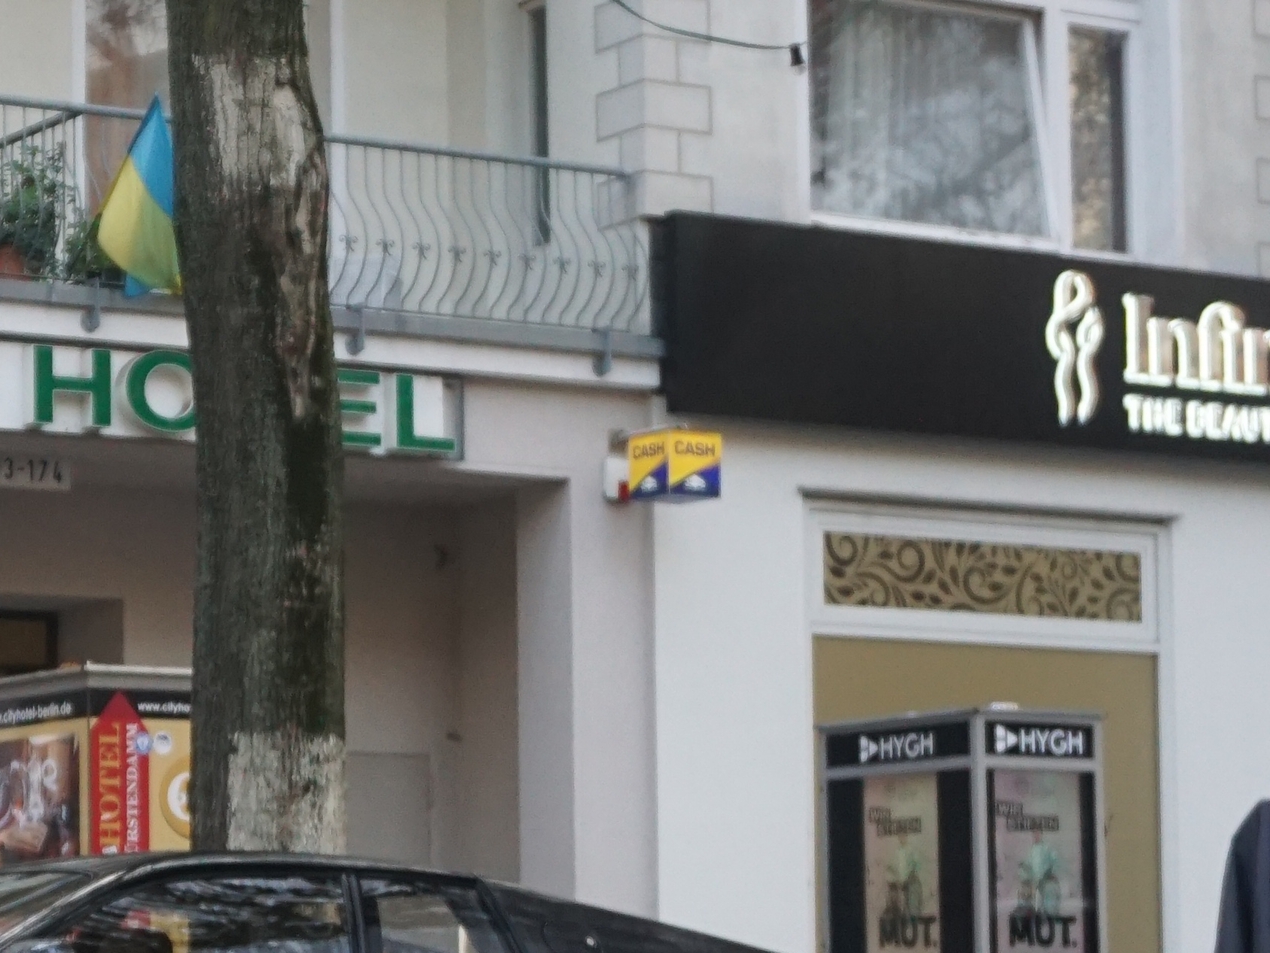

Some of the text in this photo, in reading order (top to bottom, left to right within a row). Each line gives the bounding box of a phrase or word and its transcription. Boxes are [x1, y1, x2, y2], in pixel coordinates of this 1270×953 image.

[32, 343, 456, 452] HOEL
[1123, 394, 1183, 437] THE
[633, 441, 665, 460] CASH
[674, 440, 715, 457] CASH
[881, 732, 934, 760] HYGH
[1020, 728, 1084, 756] HYGH
[98, 721, 121, 847] HOTEL
